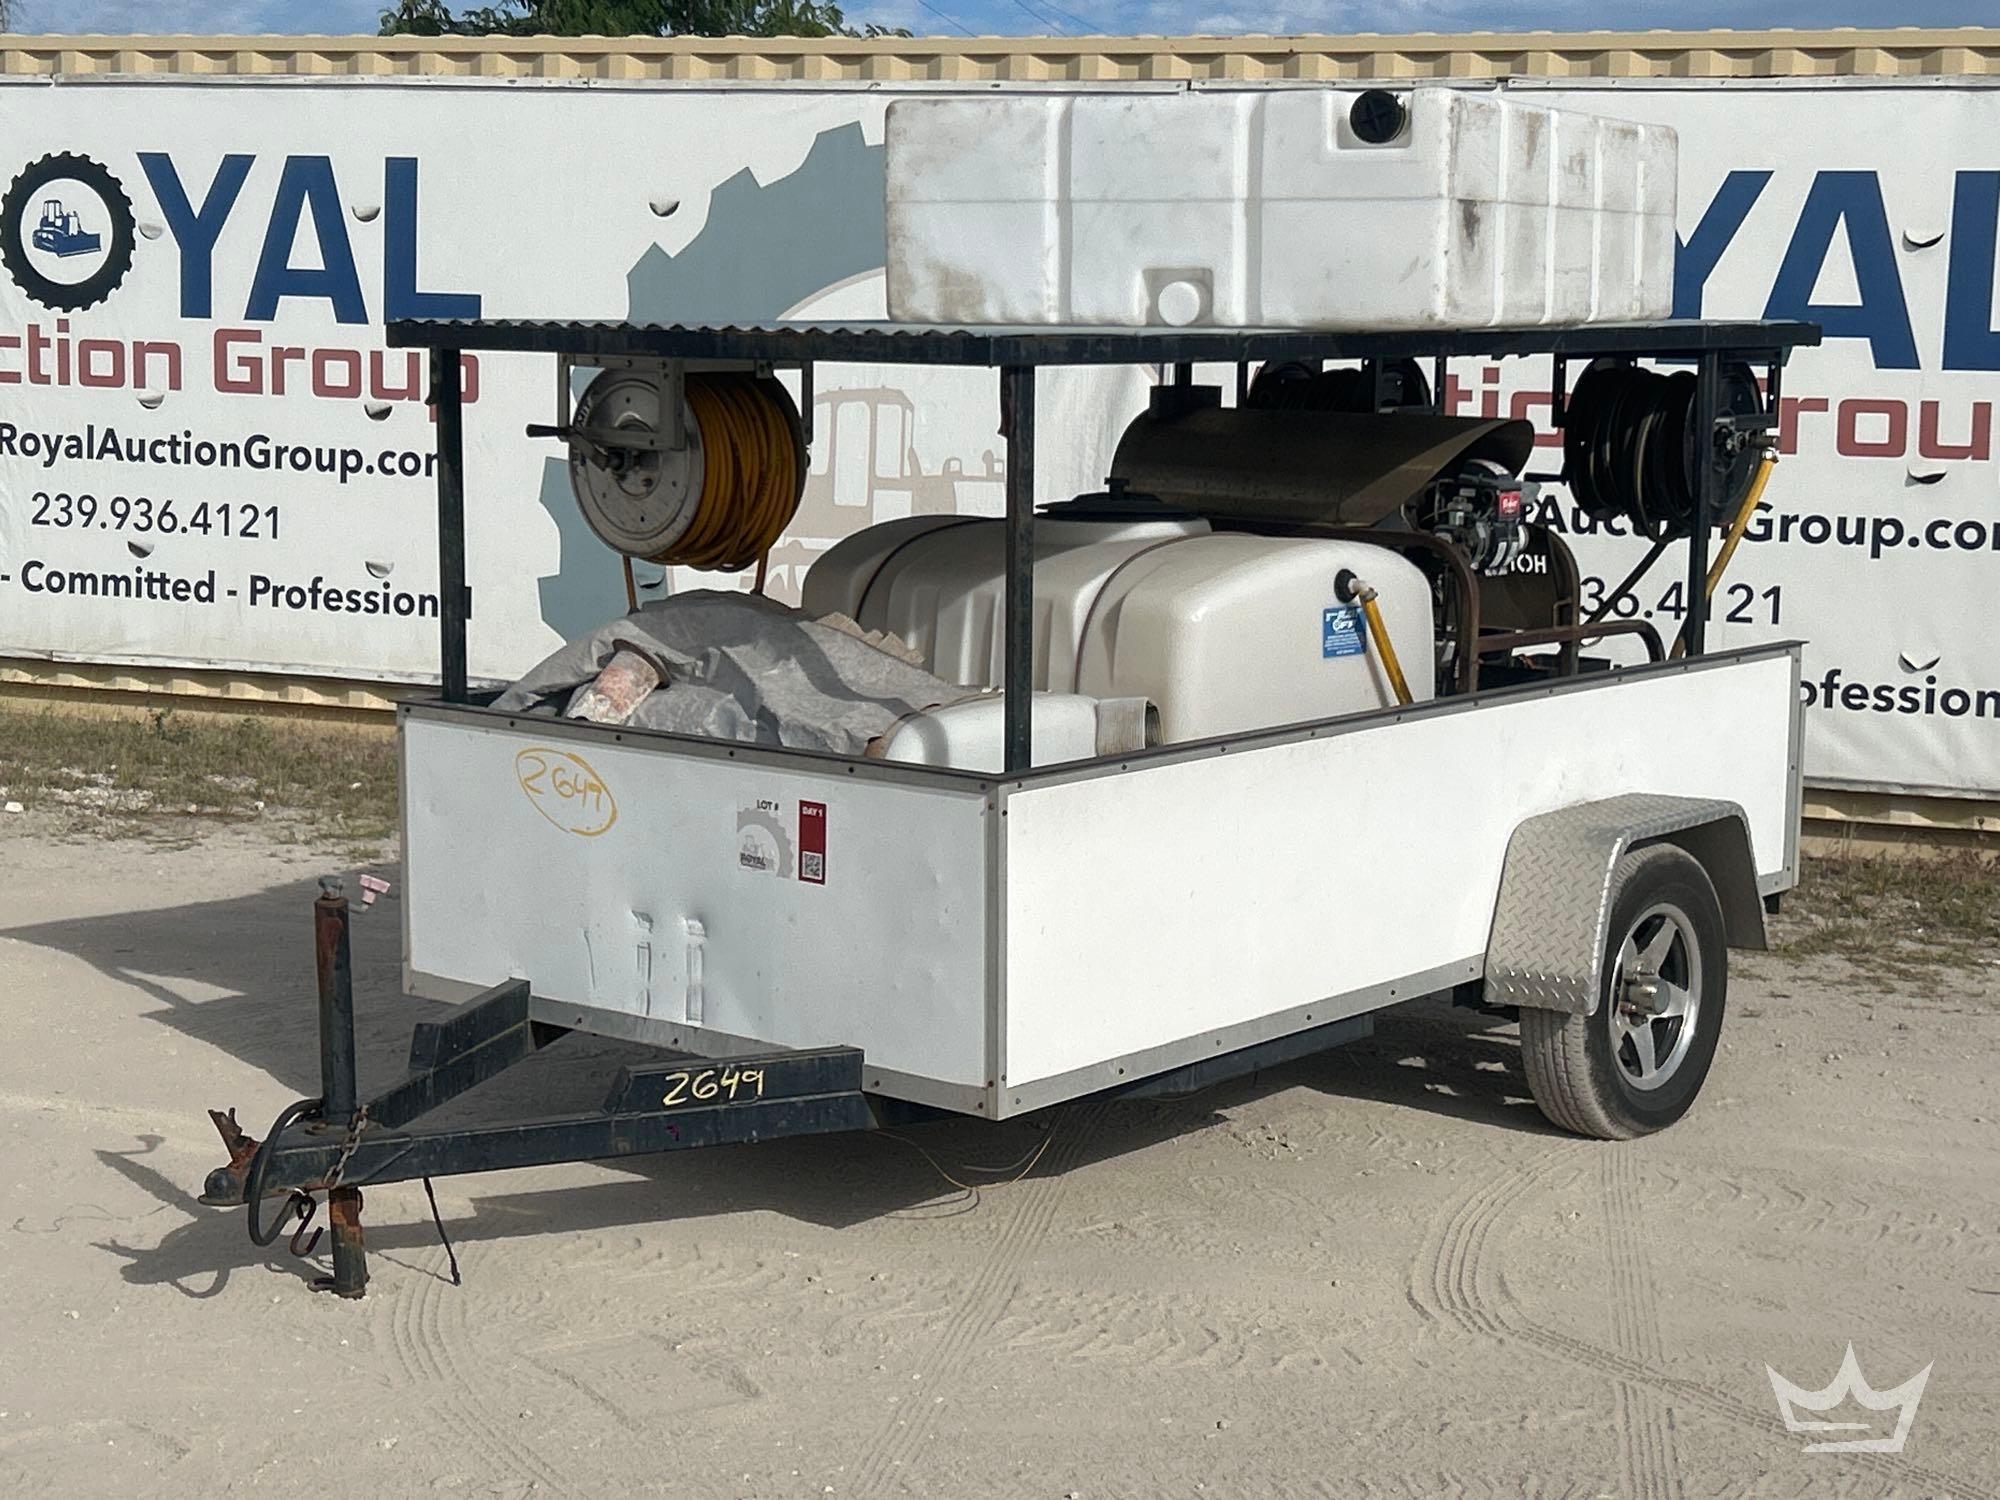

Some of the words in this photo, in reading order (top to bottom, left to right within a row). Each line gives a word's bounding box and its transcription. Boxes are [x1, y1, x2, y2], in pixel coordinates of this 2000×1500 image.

[31, 492, 281, 540] 239.936.4121
[20, 560, 215, 603] Committed
[662, 1068, 765, 1107] 2649
